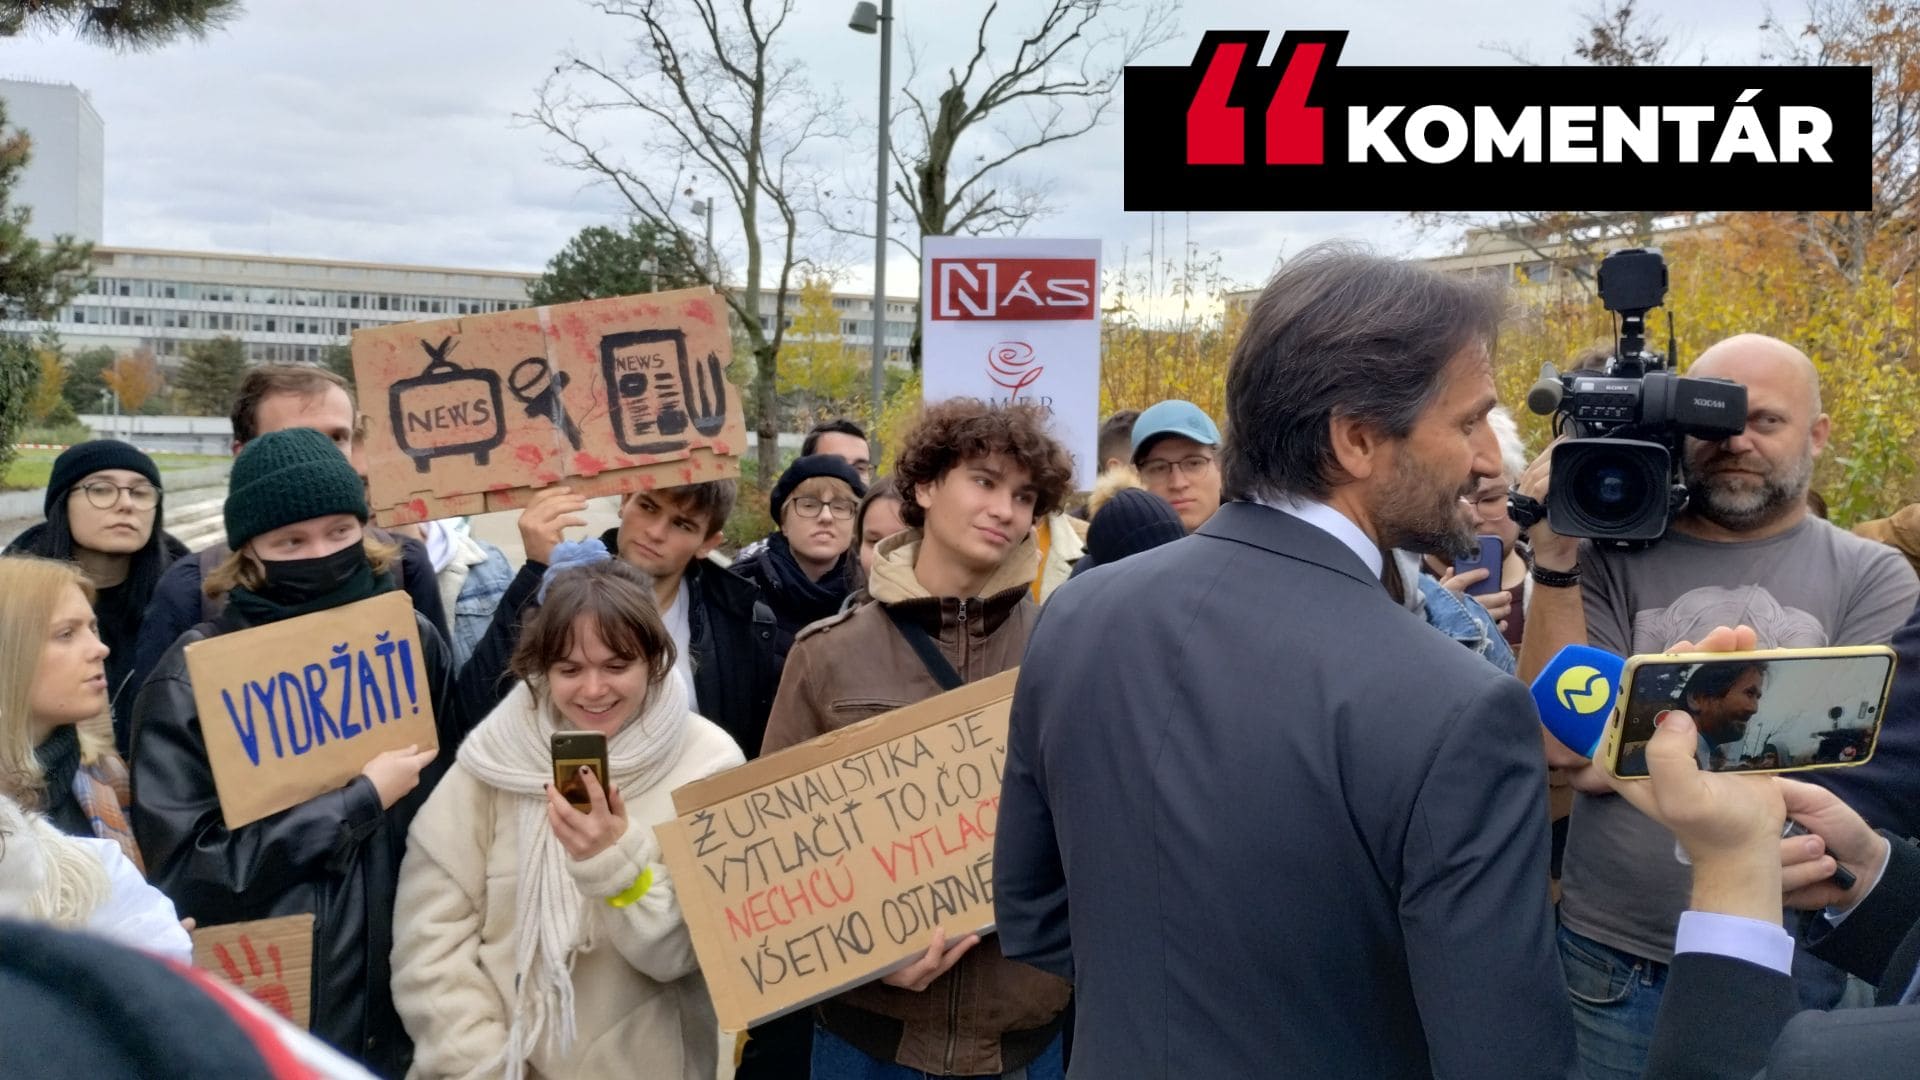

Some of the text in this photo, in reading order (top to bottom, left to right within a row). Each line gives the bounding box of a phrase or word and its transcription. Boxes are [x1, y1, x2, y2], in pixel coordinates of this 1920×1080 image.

[940, 262, 1090, 317] NÁS
[615, 352, 666, 373] NEWS
[407, 398, 492, 432] NEWS
[221, 630, 420, 767] VYDRŽAŤ!
[690, 735, 934, 858] ŽURNALISTIKA
[947, 710, 993, 753] JE
[704, 800, 865, 893] VYTLAČIŤ
[724, 856, 856, 942] NECHCÚ
[740, 853, 994, 995] VŠETKO OSTATNÉ
